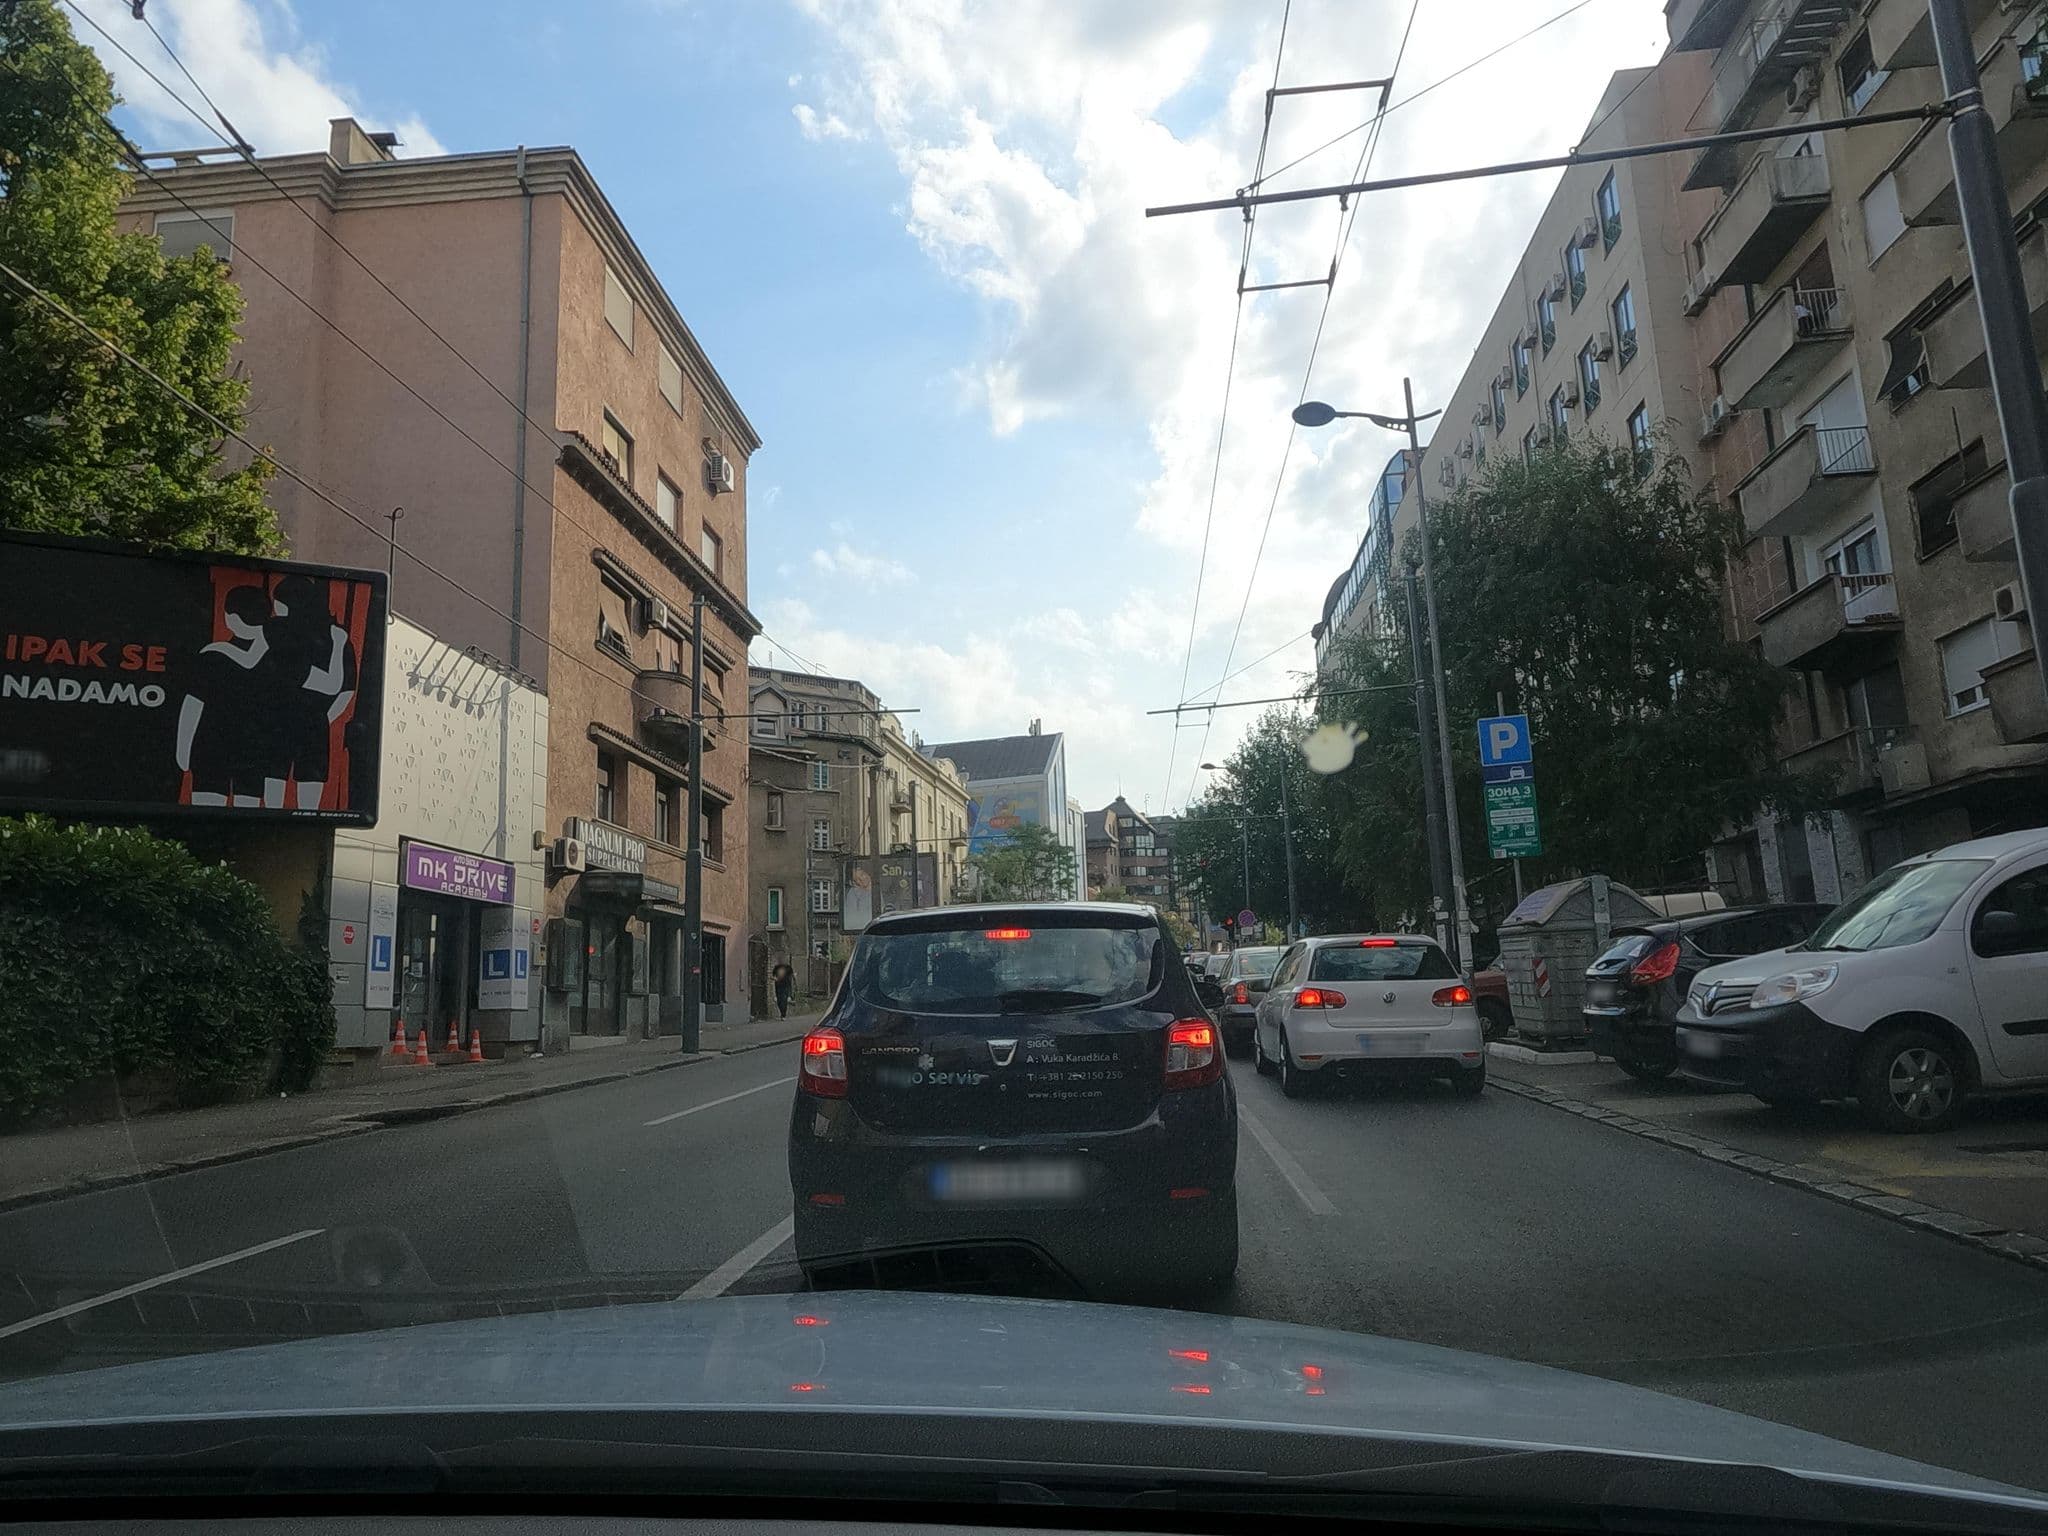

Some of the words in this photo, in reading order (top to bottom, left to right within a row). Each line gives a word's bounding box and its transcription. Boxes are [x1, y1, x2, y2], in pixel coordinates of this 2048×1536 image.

[5, 634, 108, 668] IPAK
[119, 644, 168, 672] SE
[2, 674, 166, 708] NADAMO
[1489, 722, 1519, 760] P
[580, 820, 623, 856] MAGNUM
[625, 838, 645, 863] PRO
[418, 856, 448, 881] MK
[454, 865, 508, 893] DRIVE
[586, 847, 640, 872] SUPPLEMENTS
[440, 881, 488, 899] ACADEMY
[928, 1069, 981, 1085] servis
